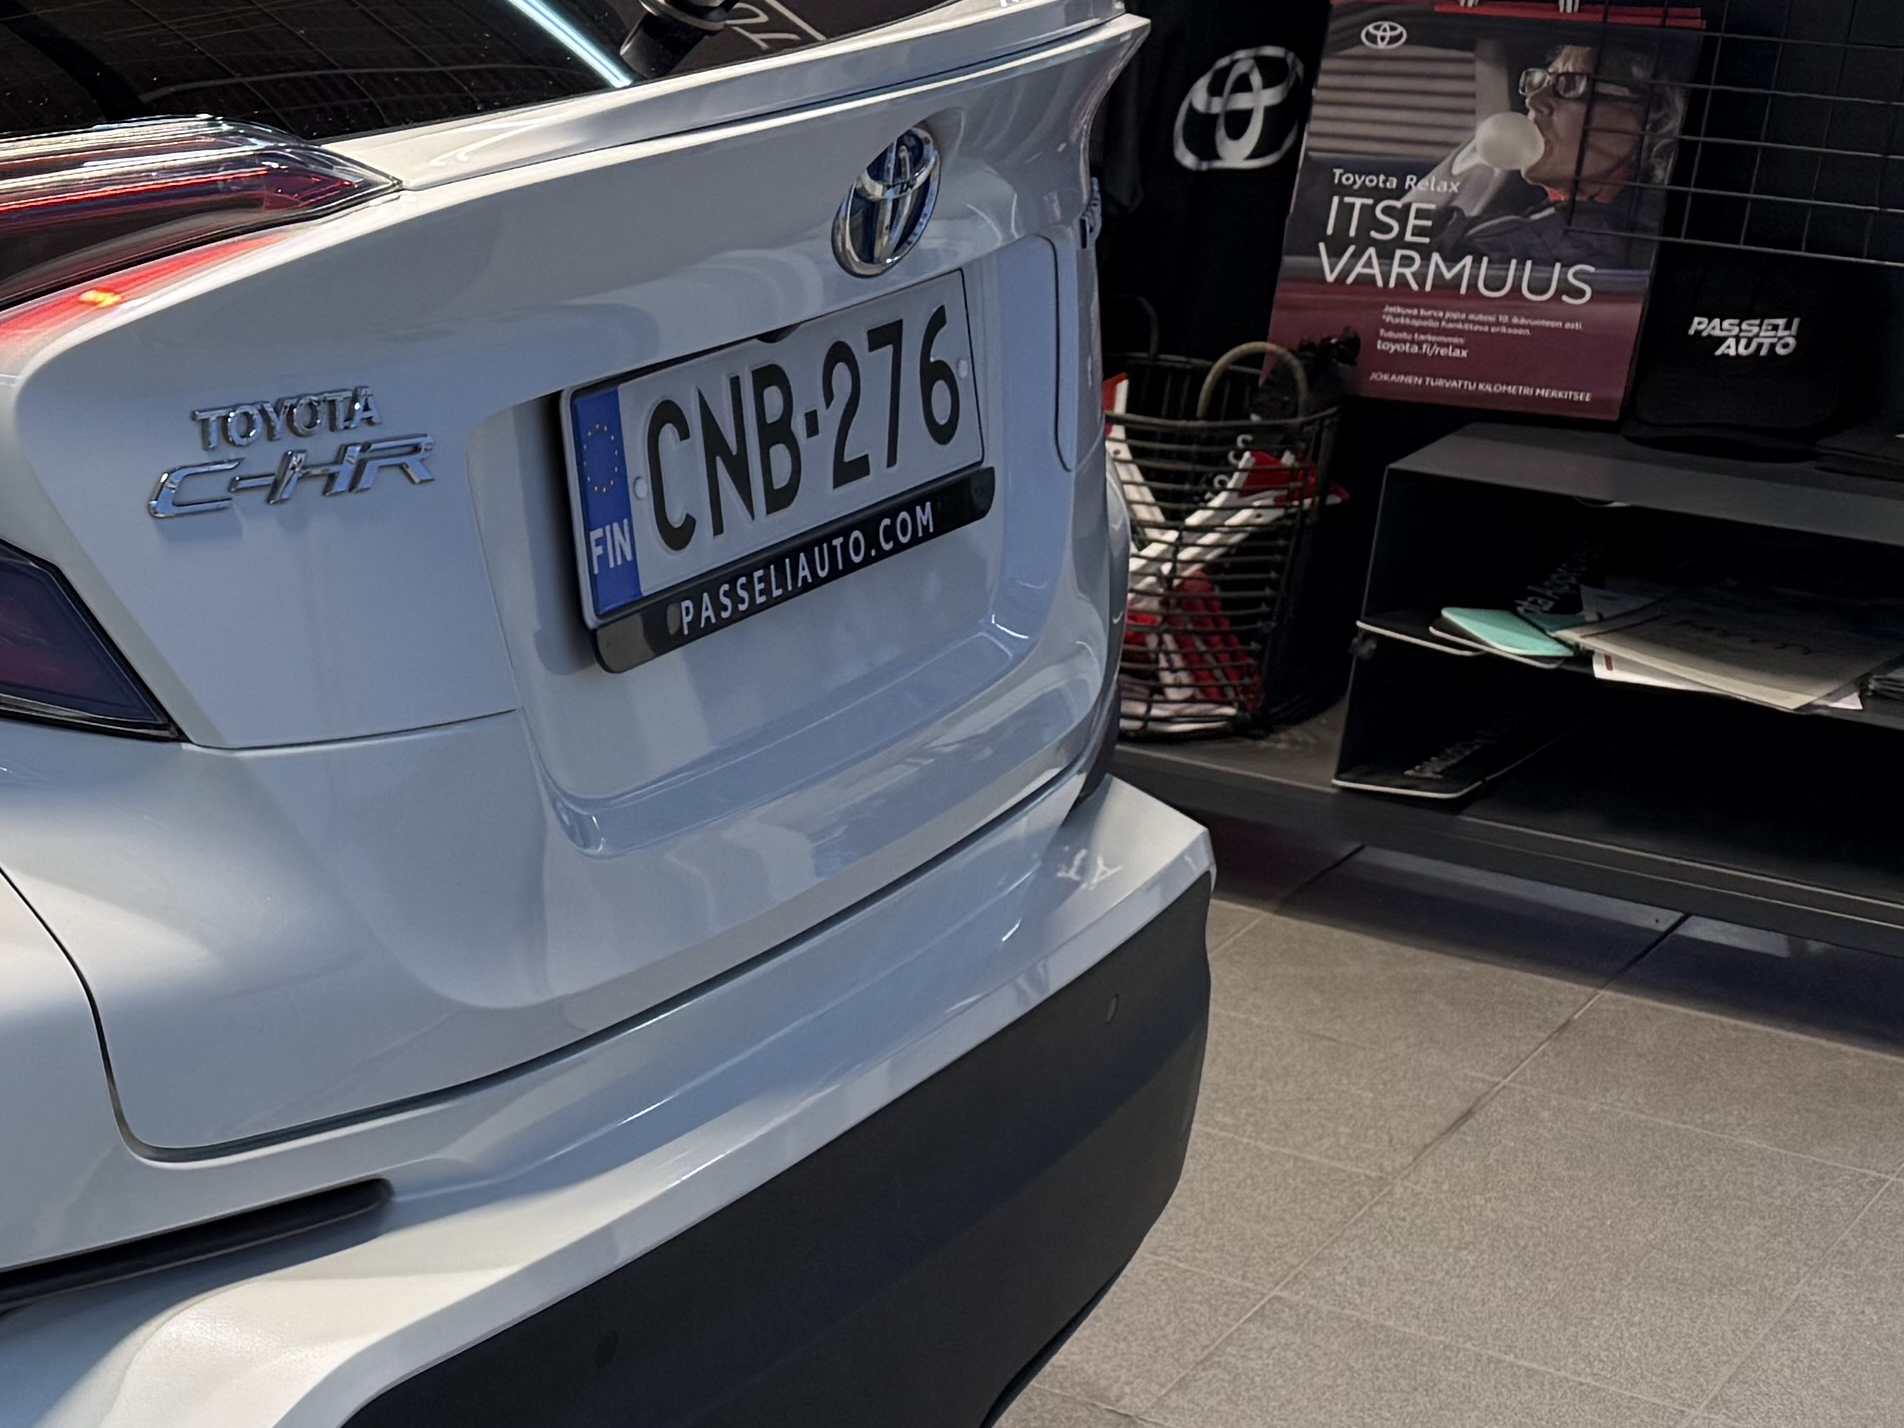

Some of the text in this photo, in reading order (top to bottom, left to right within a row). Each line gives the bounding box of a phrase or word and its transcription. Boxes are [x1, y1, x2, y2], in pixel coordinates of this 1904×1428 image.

[1332, 168, 1461, 194] Toyota Relax
[1326, 195, 1437, 244] ITSE
[1318, 241, 1596, 305] VARMUUS
[1376, 339, 1469, 358] toyota.fi/relax
[1688, 316, 1801, 337] PASSELI
[1714, 336, 1797, 356] AUTO
[1369, 371, 1592, 403] JOKAINEN TURVATTU KILOMETRI MERKITSEE
[191, 385, 382, 450] TOYOTA
[646, 304, 960, 551] CNB-276
[148, 432, 436, 519] C-HR
[589, 518, 634, 575] FIN
[680, 501, 935, 635] PASSELIAUTO.COM
